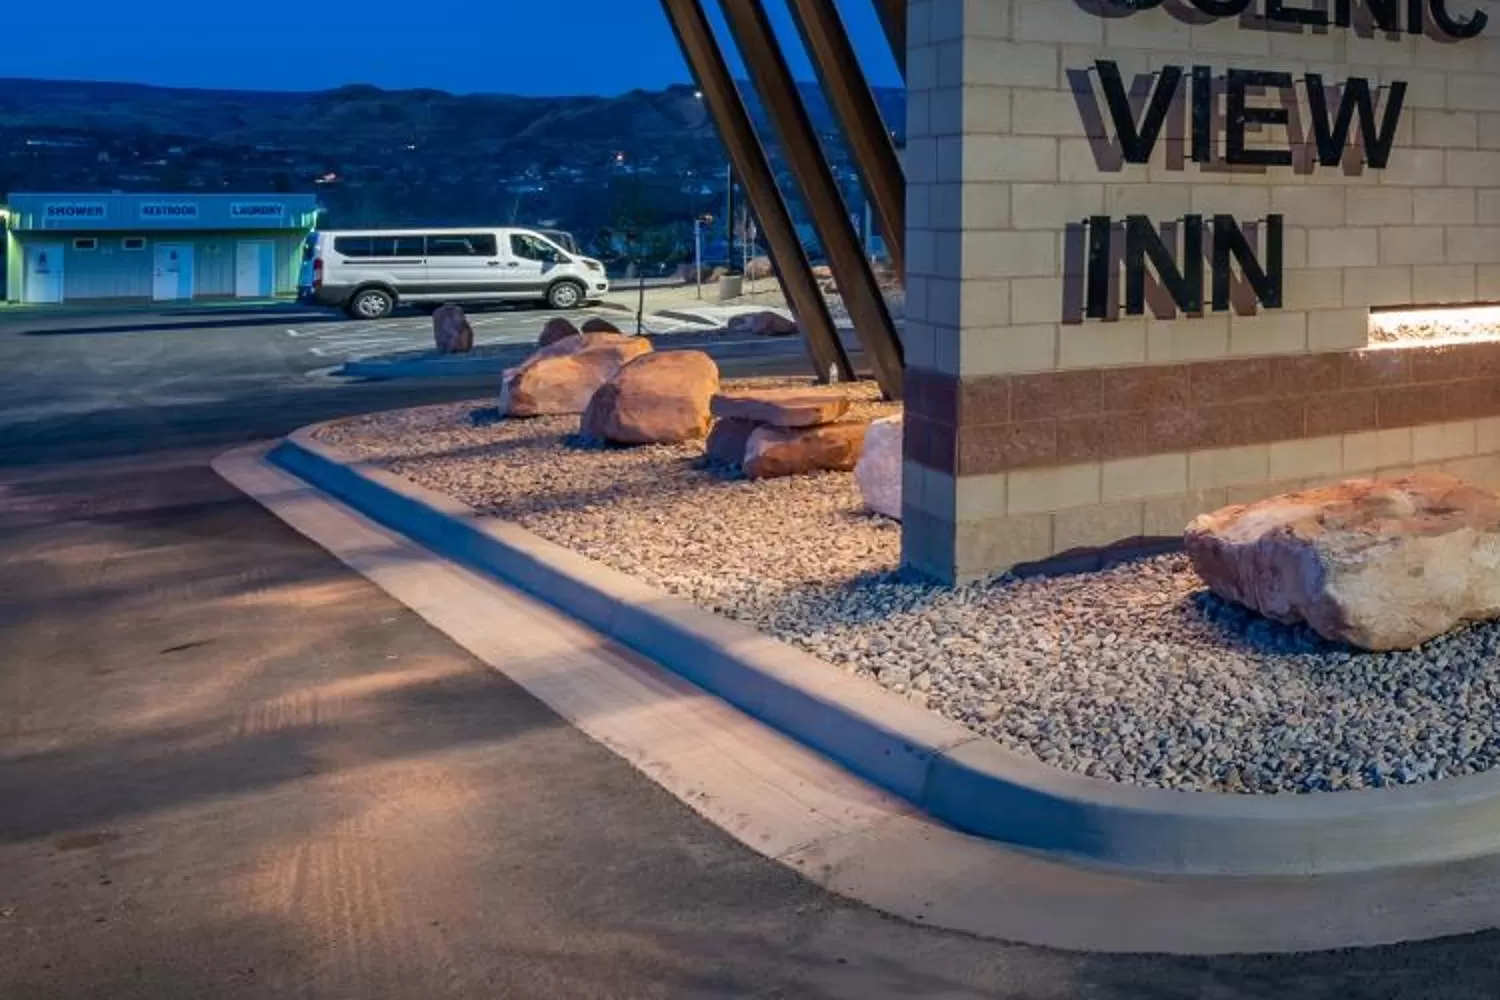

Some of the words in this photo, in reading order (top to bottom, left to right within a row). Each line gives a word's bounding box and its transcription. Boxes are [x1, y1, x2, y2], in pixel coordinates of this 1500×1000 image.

[1095, 60, 1408, 169] VIEW
[47, 206, 104, 217] SHOWER
[231, 205, 282, 216] LAUNDRY
[1086, 213, 1284, 318] INN
